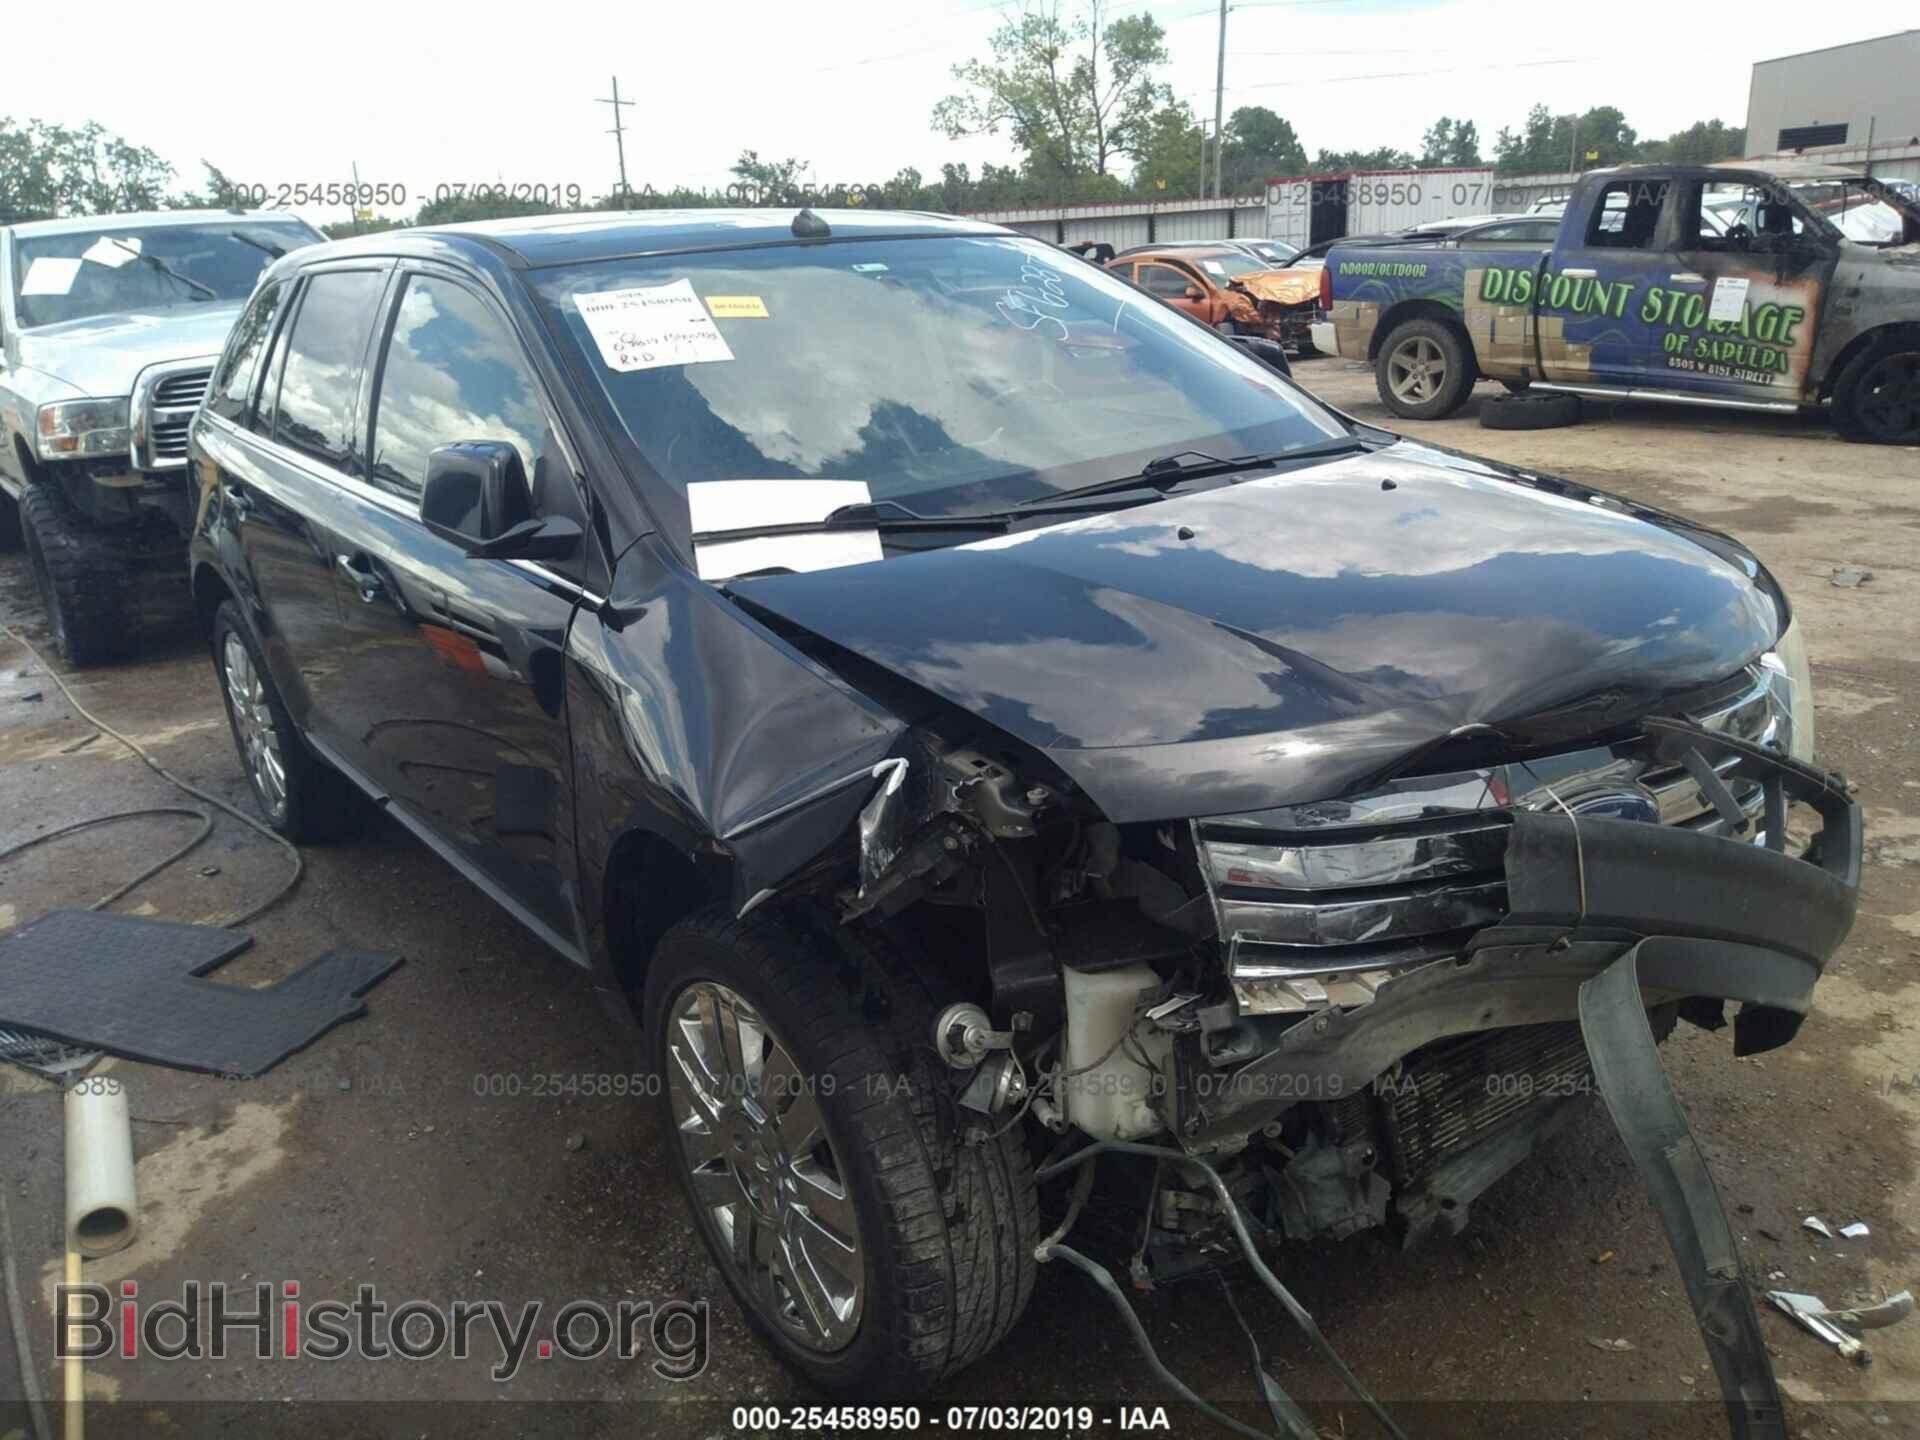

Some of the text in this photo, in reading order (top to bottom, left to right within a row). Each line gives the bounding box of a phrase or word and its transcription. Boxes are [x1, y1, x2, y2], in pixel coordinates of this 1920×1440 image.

[1339, 262, 1427, 278] INDOOR/OUTDOOR
[1483, 267, 1636, 319] DISCOUNT
[1664, 332, 1690, 353] OF
